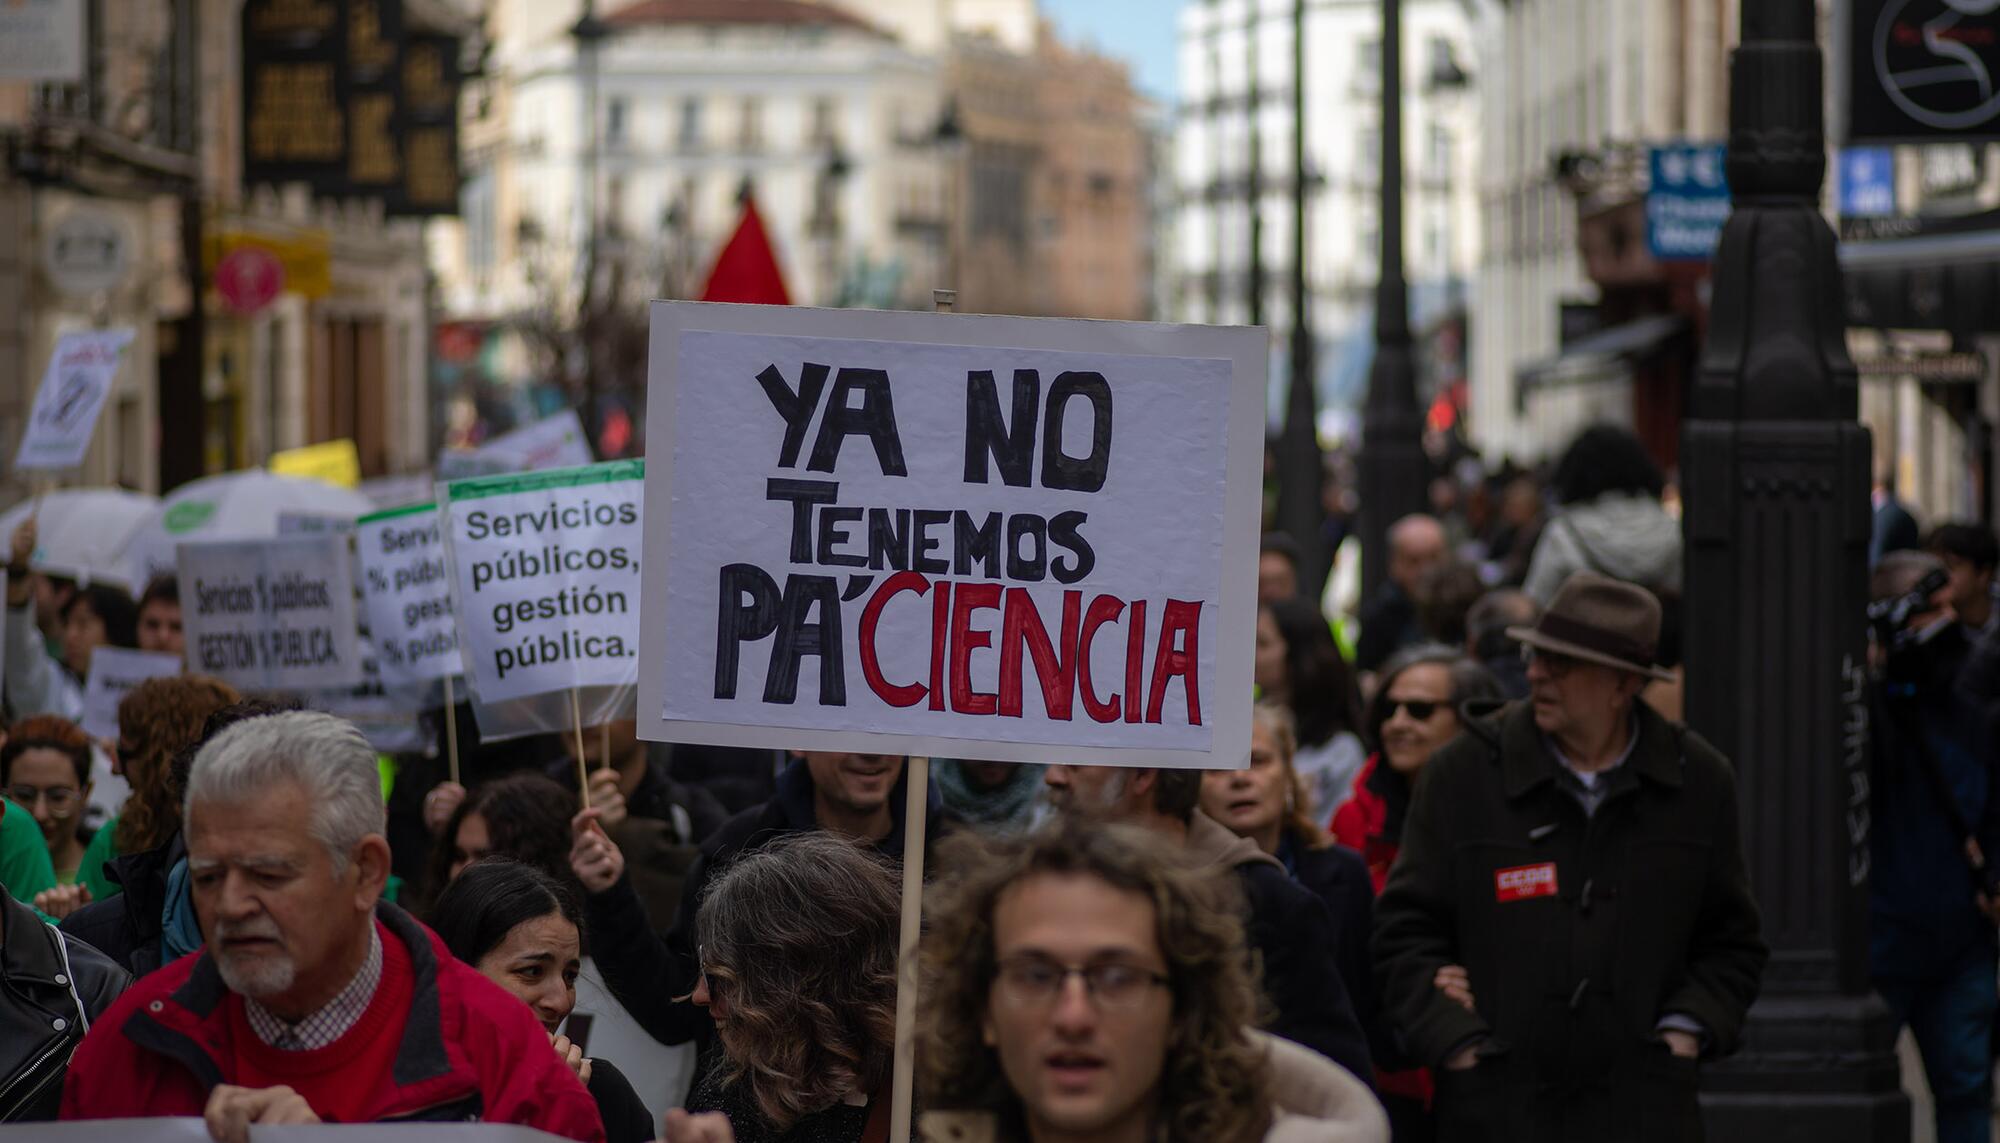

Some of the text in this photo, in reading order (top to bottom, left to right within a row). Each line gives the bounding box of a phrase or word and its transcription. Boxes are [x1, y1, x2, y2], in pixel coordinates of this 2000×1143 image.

[755, 362, 1113, 492] YA NO
[466, 500, 638, 541] Servicios
[472, 545, 640, 592] públicos,
[492, 584, 627, 633] gestión
[494, 630, 636, 679] pública.
